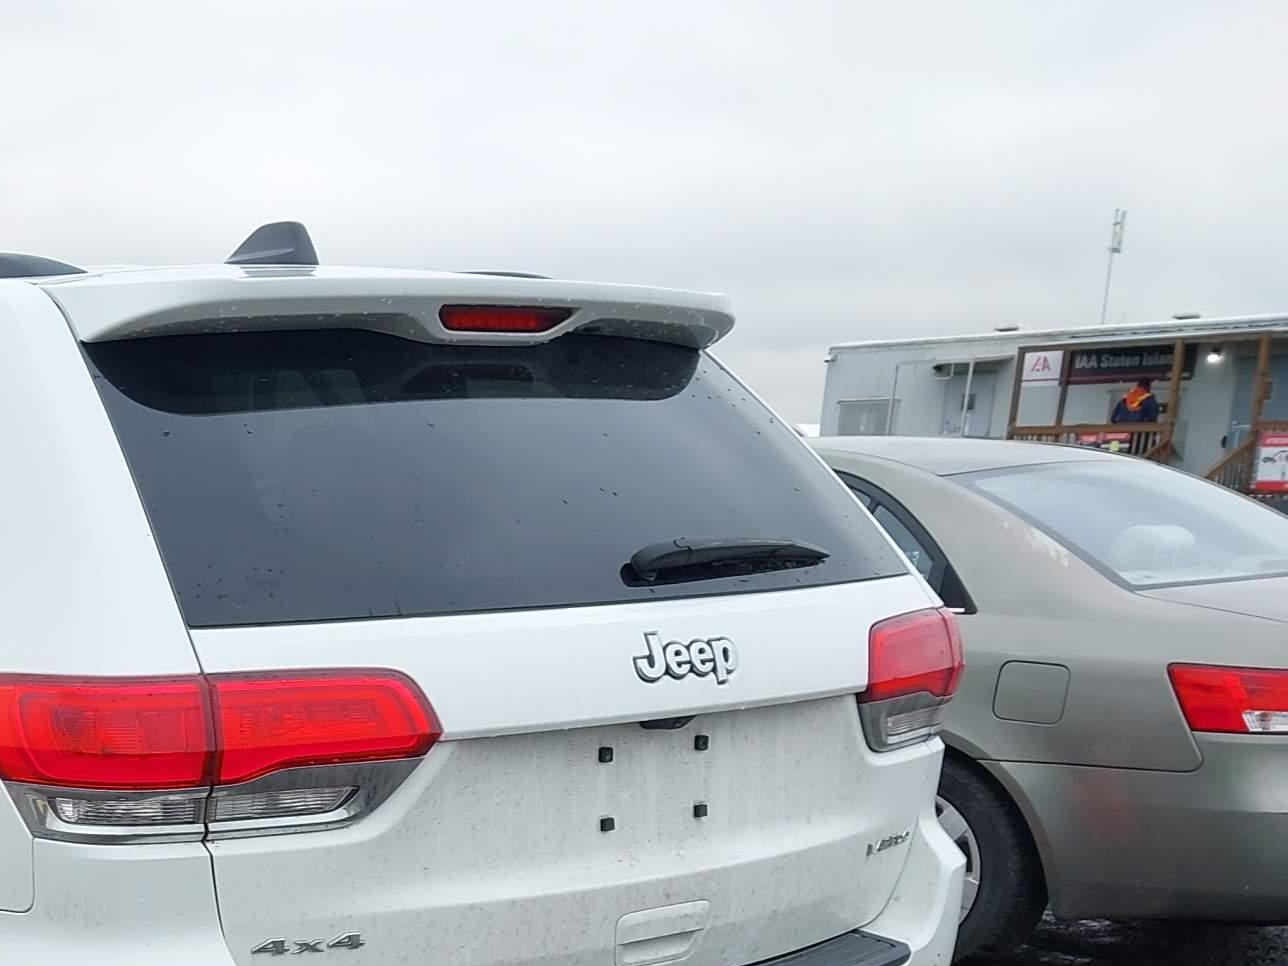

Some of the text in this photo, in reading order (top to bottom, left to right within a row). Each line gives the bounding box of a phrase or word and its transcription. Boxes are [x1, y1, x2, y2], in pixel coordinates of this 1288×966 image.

[1075, 350, 1175, 369] IAA Staten Islan
[632, 631, 739, 686] Jeep
[250, 929, 368, 956] 4x4
